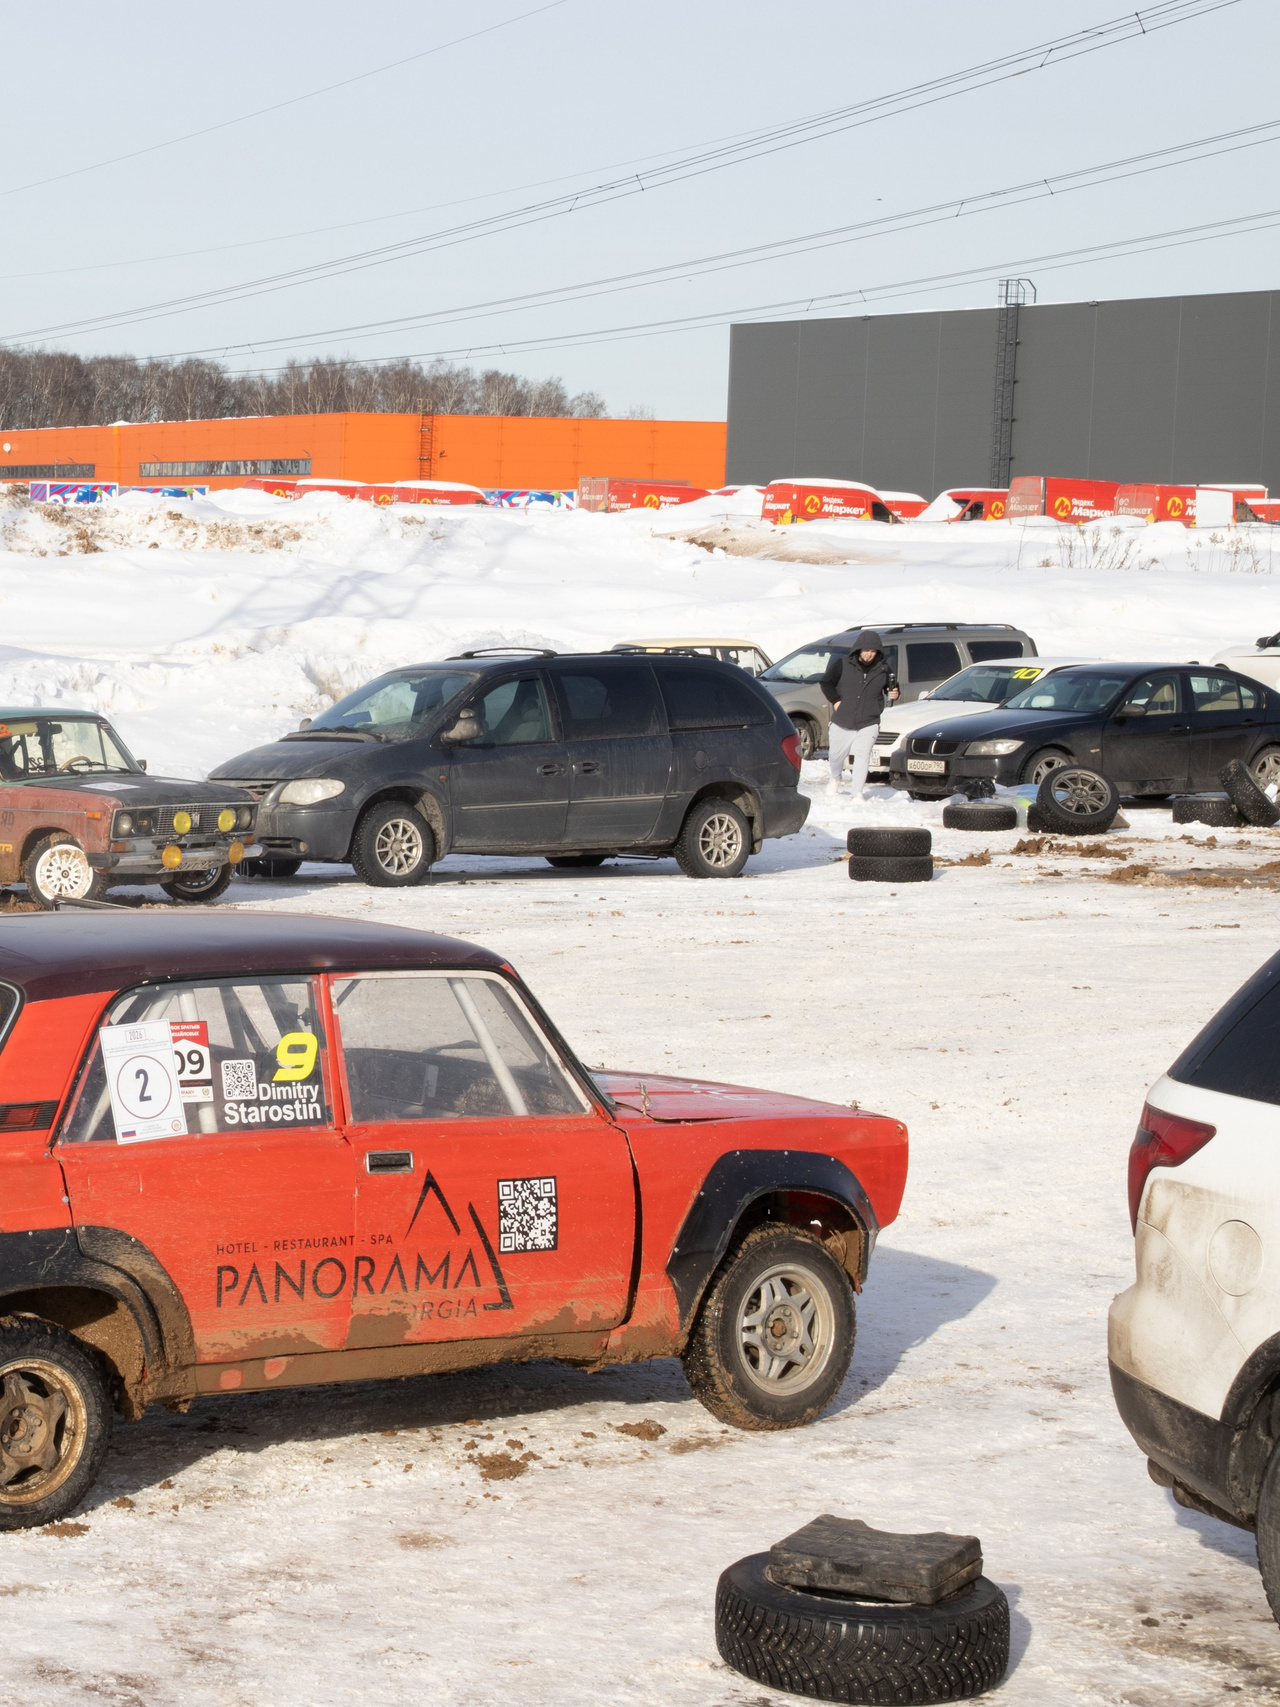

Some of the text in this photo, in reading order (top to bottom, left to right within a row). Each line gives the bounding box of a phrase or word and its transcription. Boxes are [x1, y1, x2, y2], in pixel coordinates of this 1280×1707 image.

[764, 502, 791, 510] Маркет
[822, 496, 844, 504] Яндекс
[1071, 498, 1095, 506] Яндекс
[821, 504, 866, 516] Маркет
[1117, 506, 1153, 515] Маркет
[1012, 668, 1042, 680] 10
[128, 1030, 143, 1041] 2026
[272, 1032, 318, 1081] 9
[135, 1068, 152, 1102] 2
[258, 1083, 319, 1102] Dimitry
[224, 1099, 321, 1124] Starostin
[216, 1242, 258, 1255] HOTEL
[274, 1235, 355, 1252] RESTAURANT
[370, 1234, 393, 1245] SPA
[216, 1247, 482, 1308] PANORAMA
